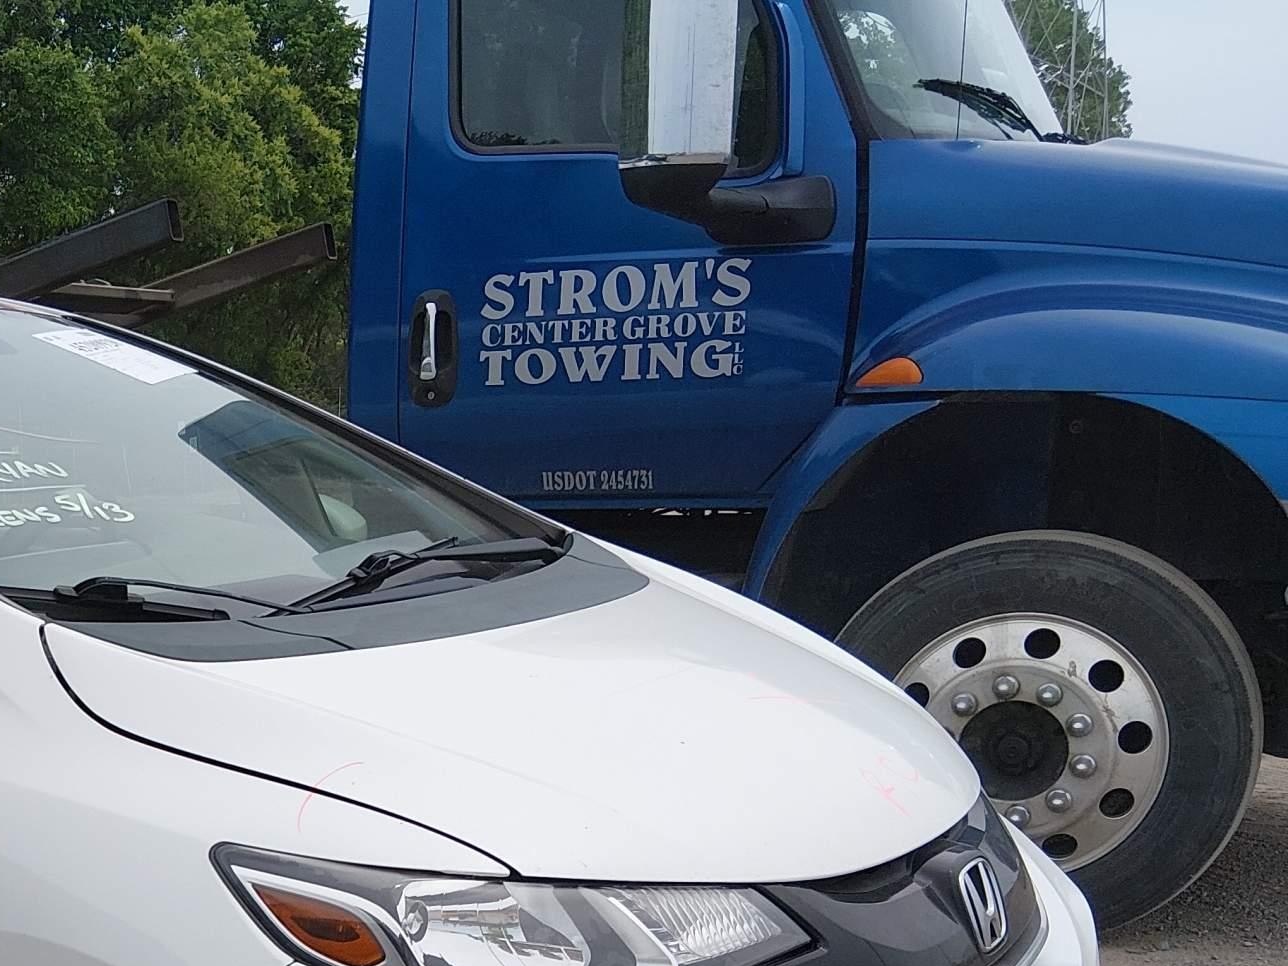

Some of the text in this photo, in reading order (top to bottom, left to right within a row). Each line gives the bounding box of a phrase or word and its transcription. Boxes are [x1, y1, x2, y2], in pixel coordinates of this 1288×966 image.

[481, 258, 753, 319] STROM'S
[481, 310, 746, 347] CENTER GROVE
[479, 339, 733, 386] TOWING
[542, 470, 654, 491] USDOT 2454731
